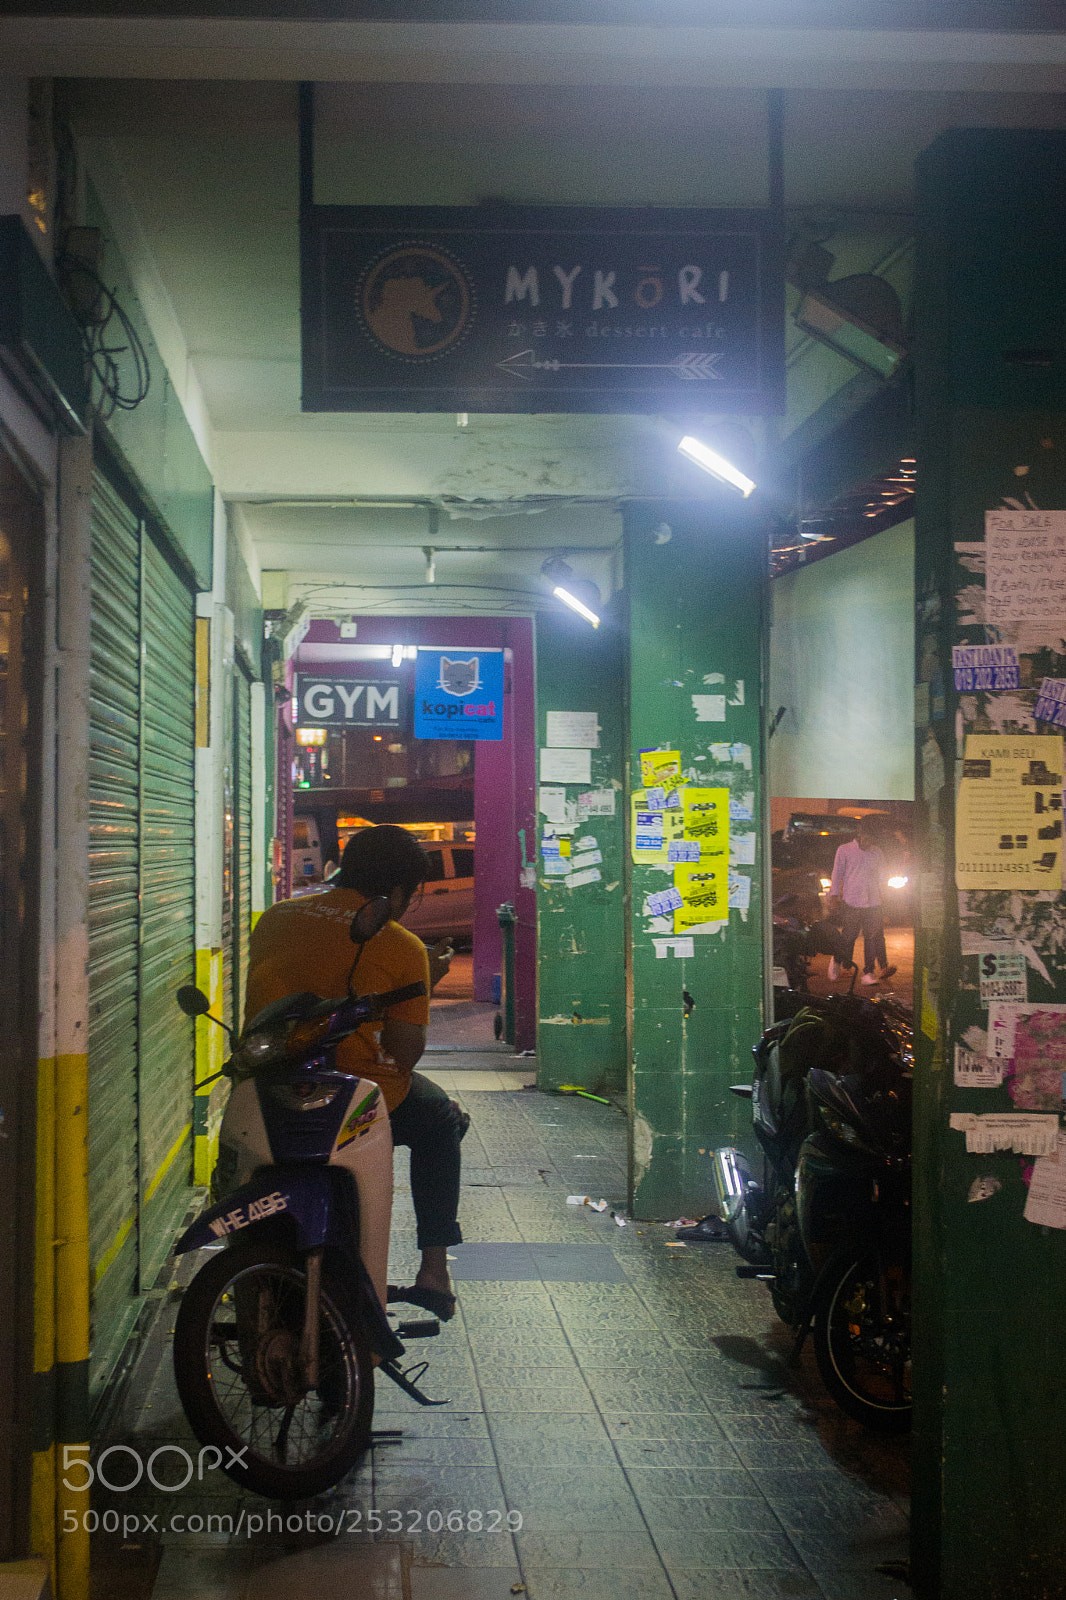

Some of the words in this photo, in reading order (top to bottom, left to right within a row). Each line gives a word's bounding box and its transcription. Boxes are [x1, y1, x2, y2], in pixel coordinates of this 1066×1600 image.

[585, 321, 667, 338] dessert
[679, 322, 726, 338] cafe
[304, 684, 399, 720] GYM
[423, 700, 496, 718] kopicat
[208, 1208, 250, 1237] WHE
